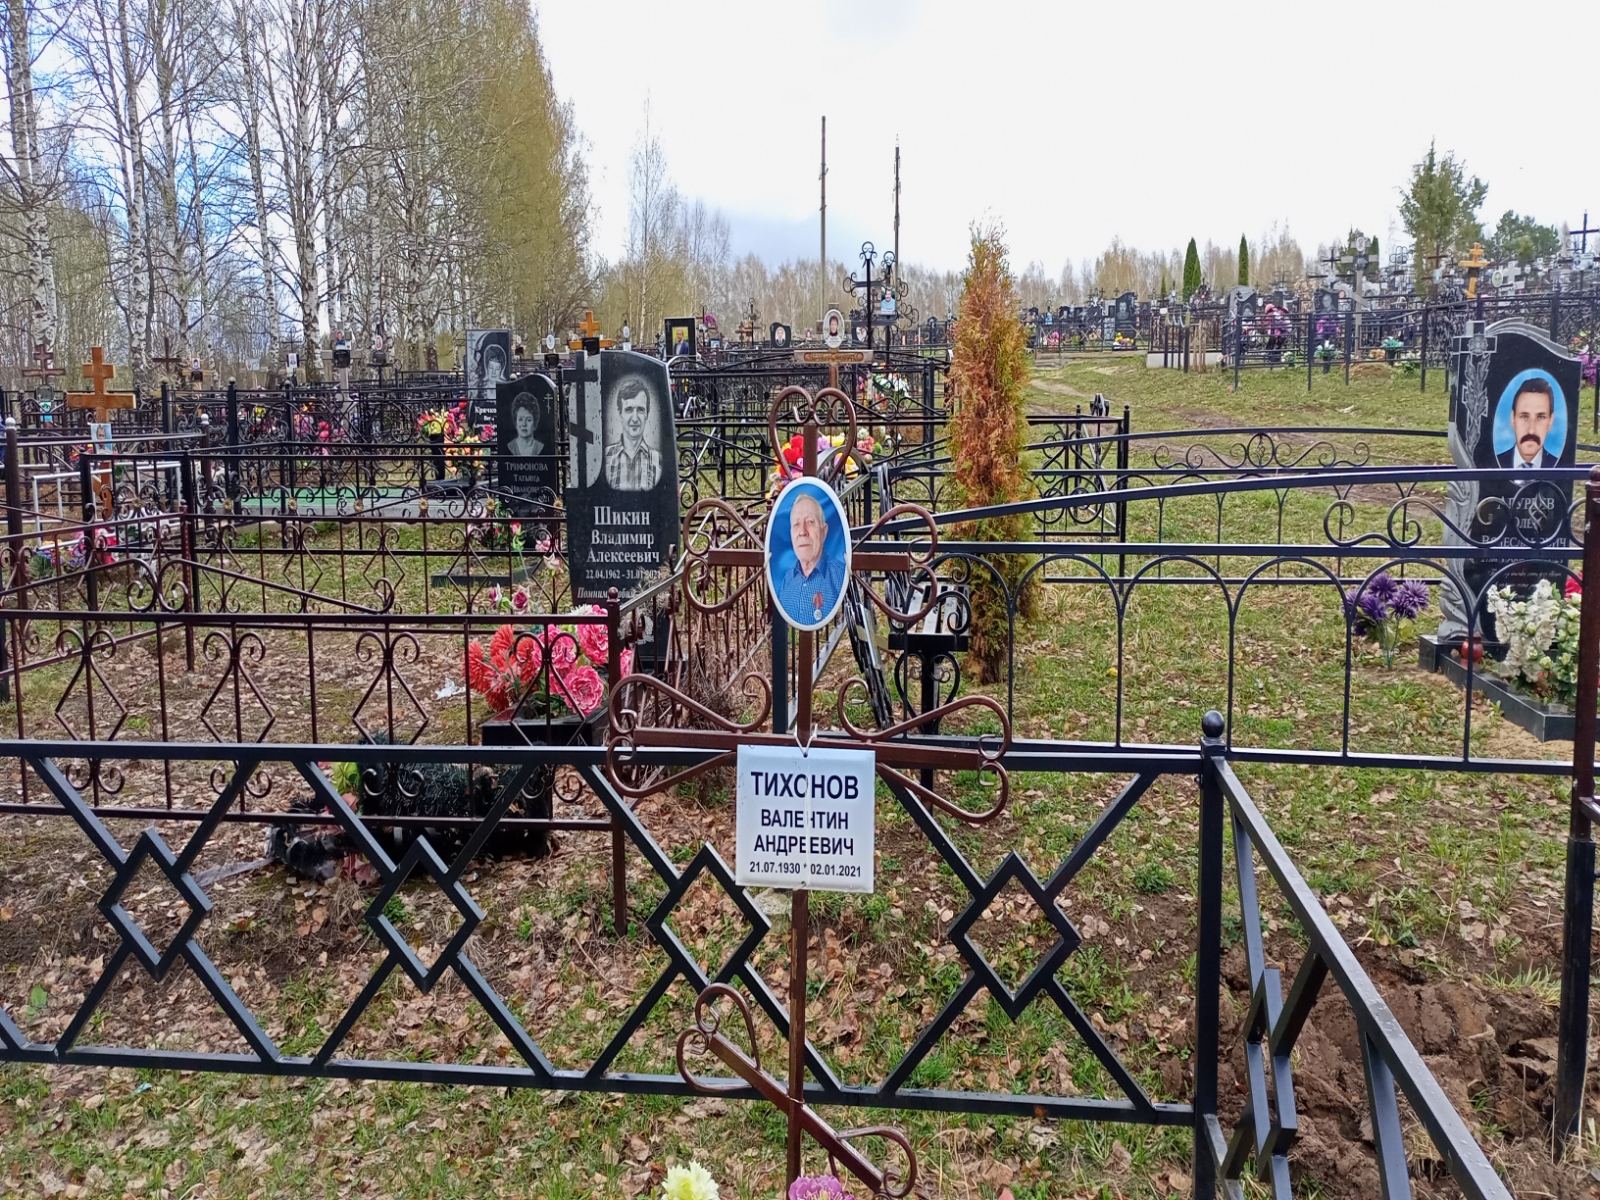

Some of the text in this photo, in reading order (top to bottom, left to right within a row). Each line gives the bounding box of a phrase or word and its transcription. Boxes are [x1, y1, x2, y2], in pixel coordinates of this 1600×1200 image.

[593, 506, 651, 526] Шикин
[591, 529, 655, 549] Владимир
[586, 548, 660, 563] Алексеевич
[585, 569, 621, 580] 22.04.1962
[750, 771, 859, 800] ТИХОНОВ
[753, 834, 854, 856] АНДРЕЕВИЧ
[749, 861, 801, 875] 21.07.1930
[810, 864, 862, 878] 02.01.2021
